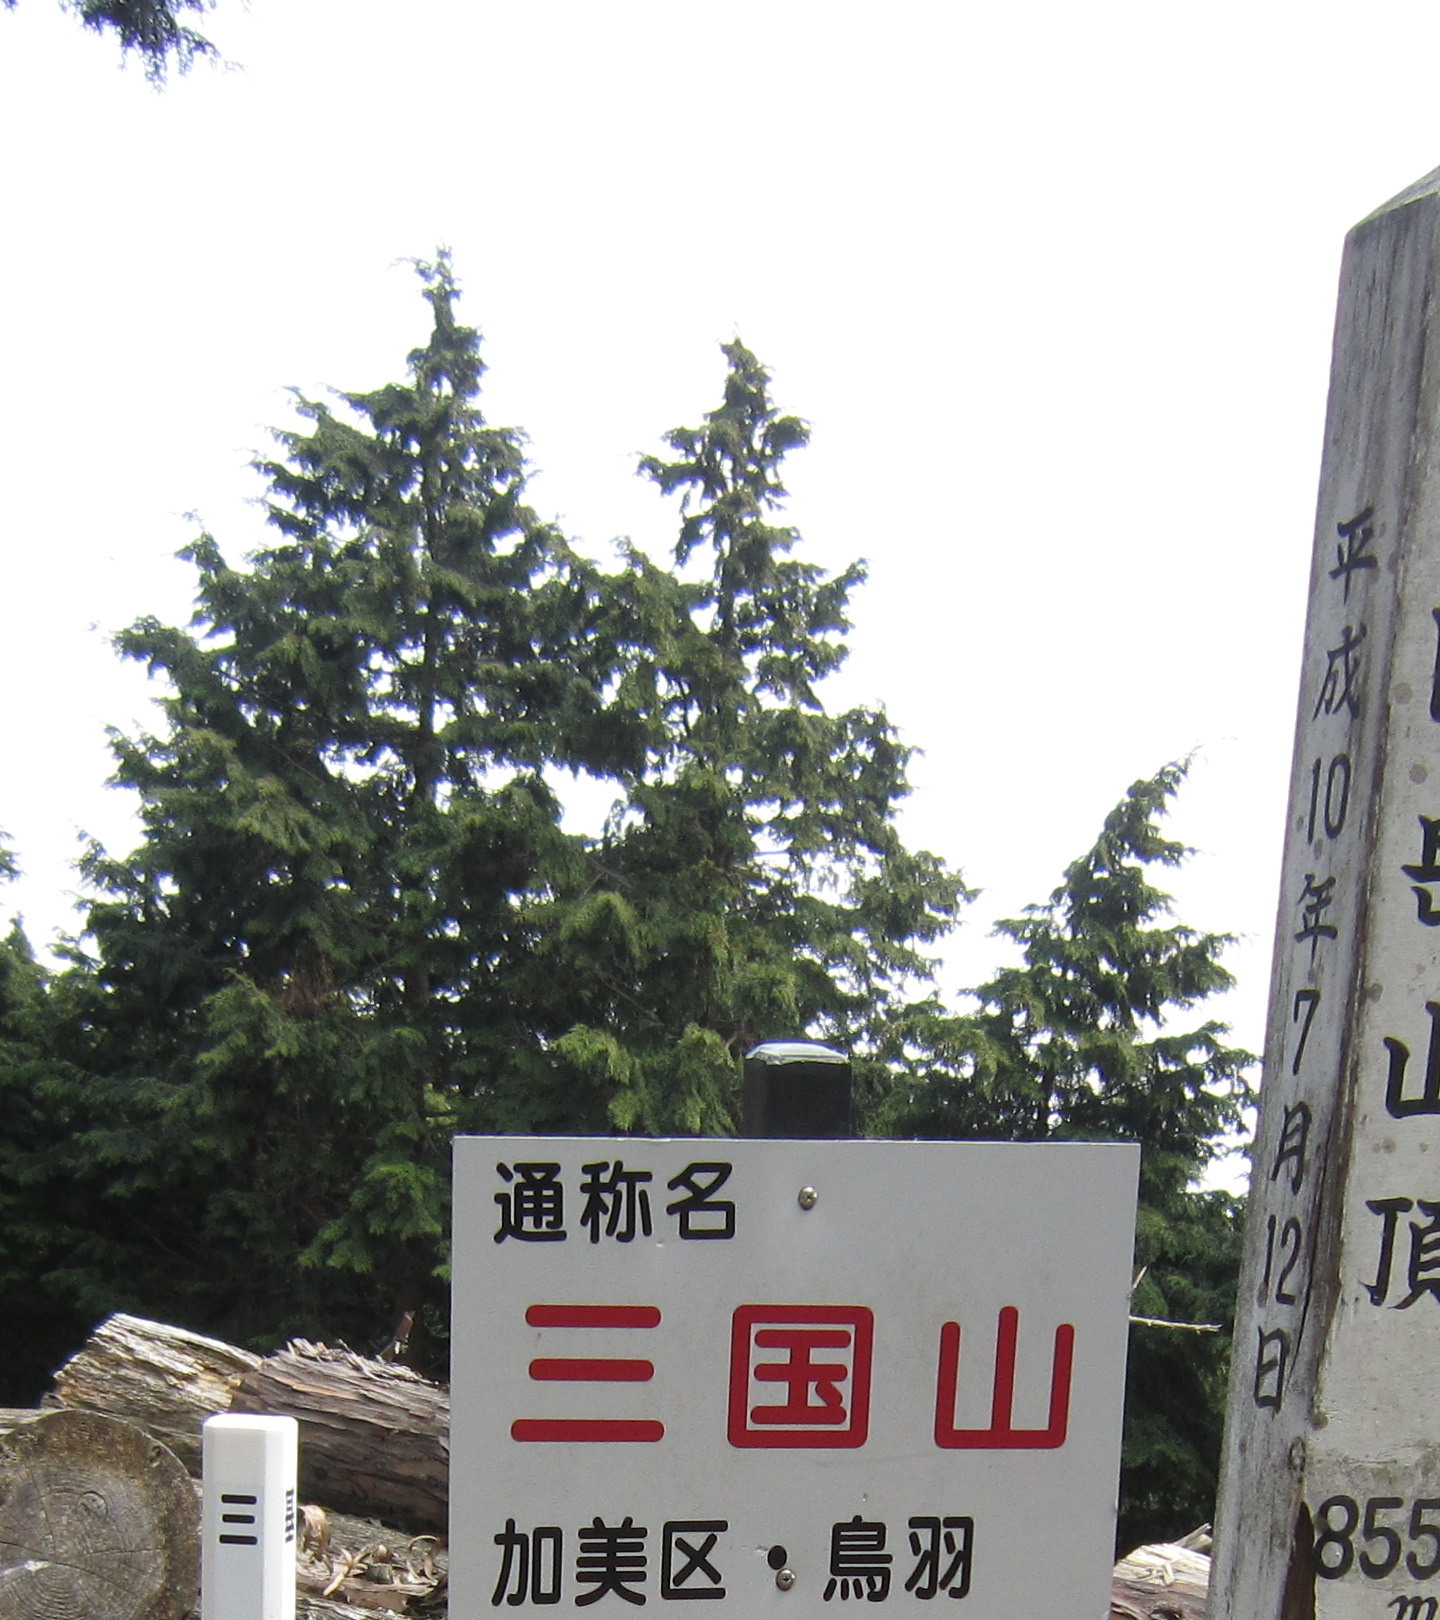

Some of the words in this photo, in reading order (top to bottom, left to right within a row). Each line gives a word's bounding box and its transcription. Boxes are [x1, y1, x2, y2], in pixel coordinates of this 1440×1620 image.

[1253, 507, 1379, 1413] 平成10年7月12日
[492, 1160, 736, 1245] 通称名
[510, 1303, 1075, 1450] 三国山
[490, 1515, 975, 1608] 加美区・鳥羽
